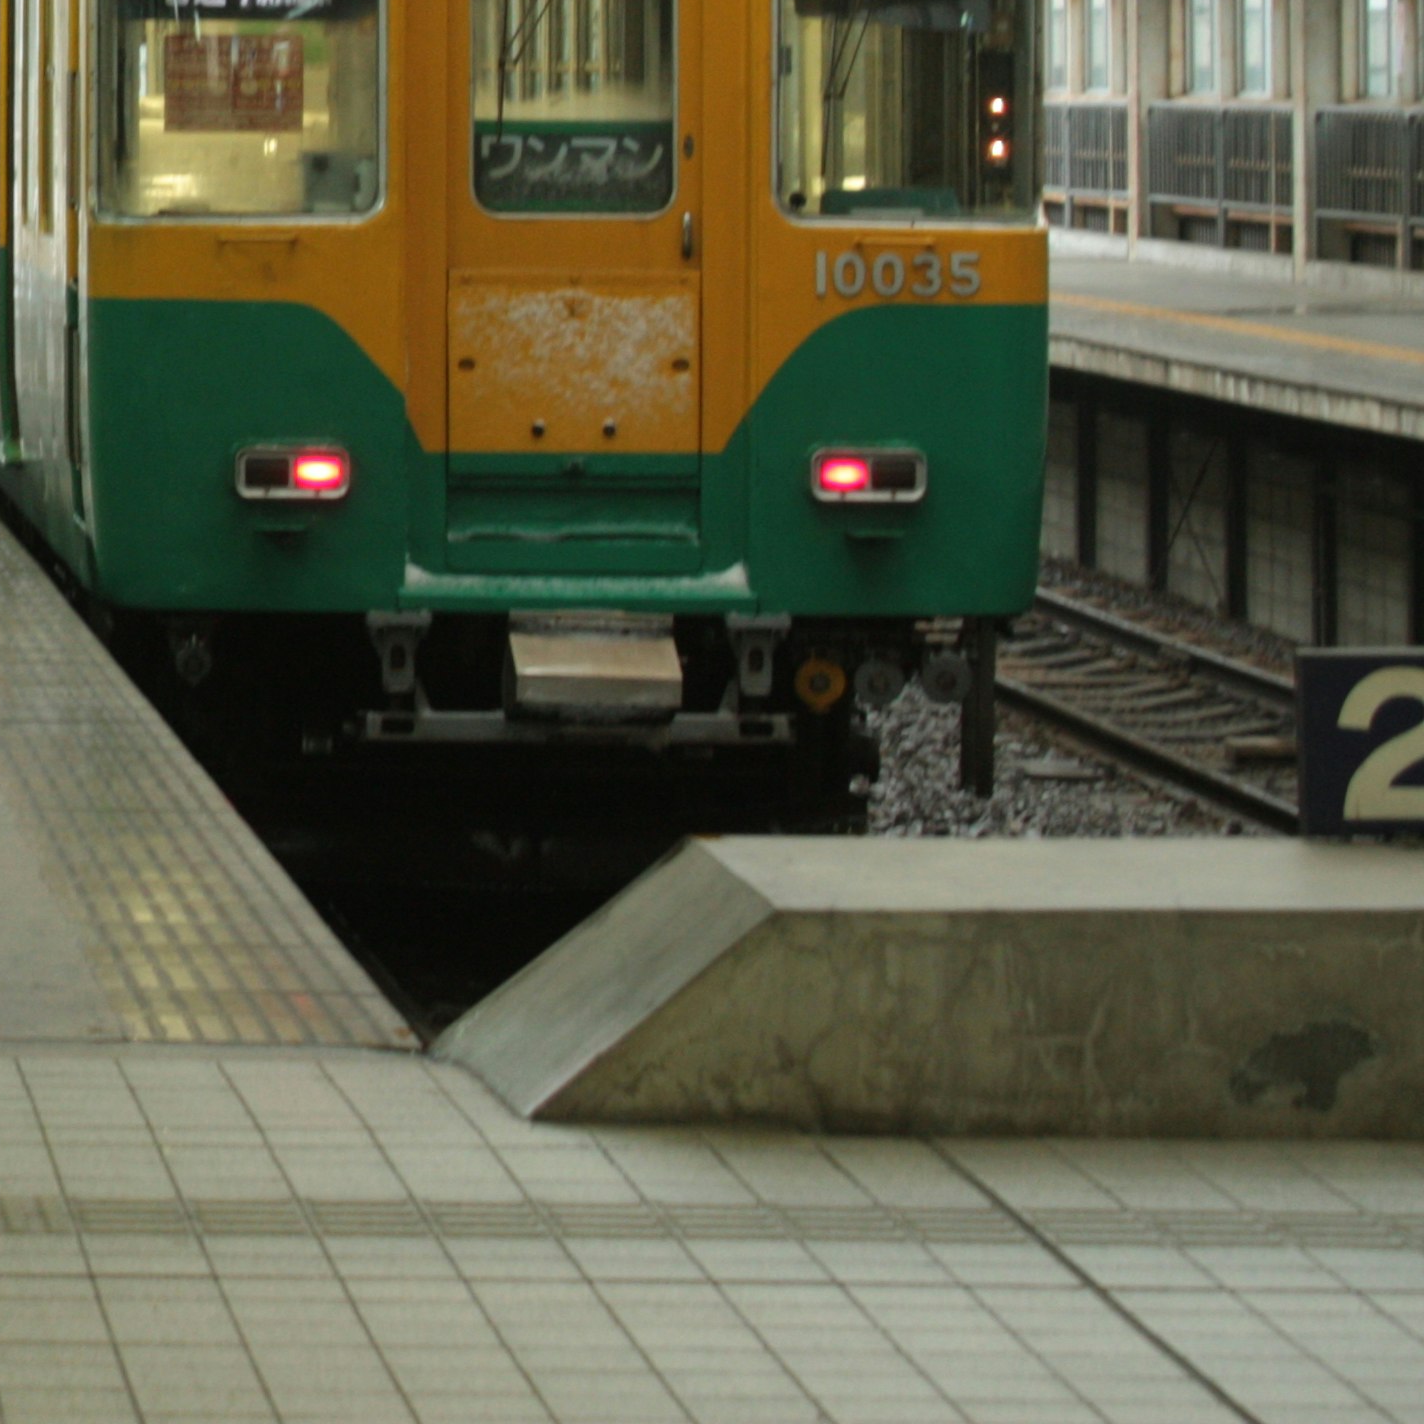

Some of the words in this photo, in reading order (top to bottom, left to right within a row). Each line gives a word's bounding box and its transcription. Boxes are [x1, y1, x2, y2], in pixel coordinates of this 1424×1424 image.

[481, 135, 664, 182] ワンマン
[816, 251, 981, 297] 10035
[1337, 665, 1424, 821] 2
